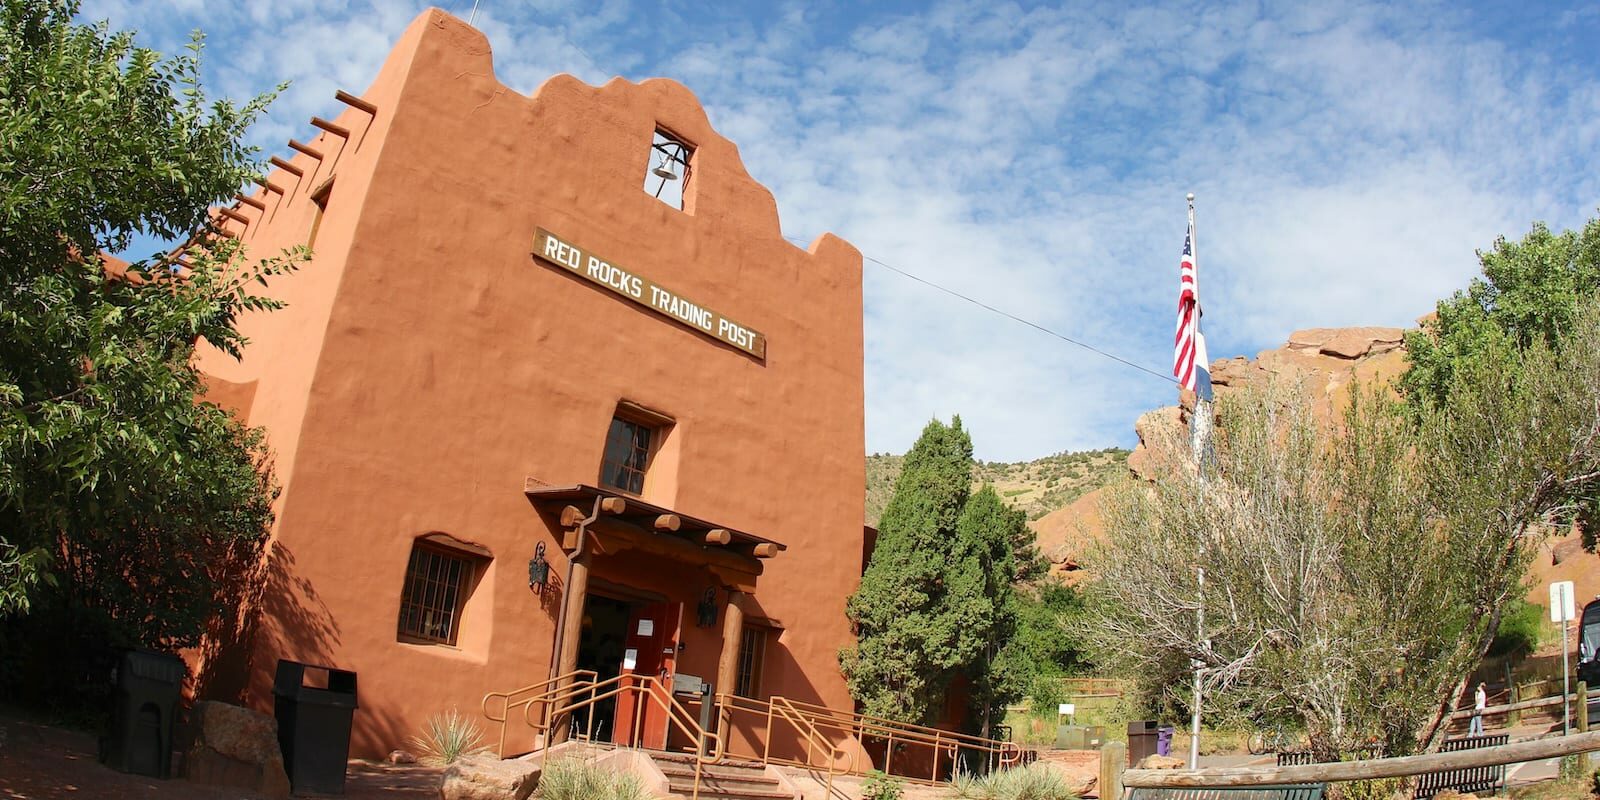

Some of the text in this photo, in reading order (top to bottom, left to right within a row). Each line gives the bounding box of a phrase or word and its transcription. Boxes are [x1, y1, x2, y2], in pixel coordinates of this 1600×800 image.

[544, 235, 756, 350] RED ROCKS TRADING POST
